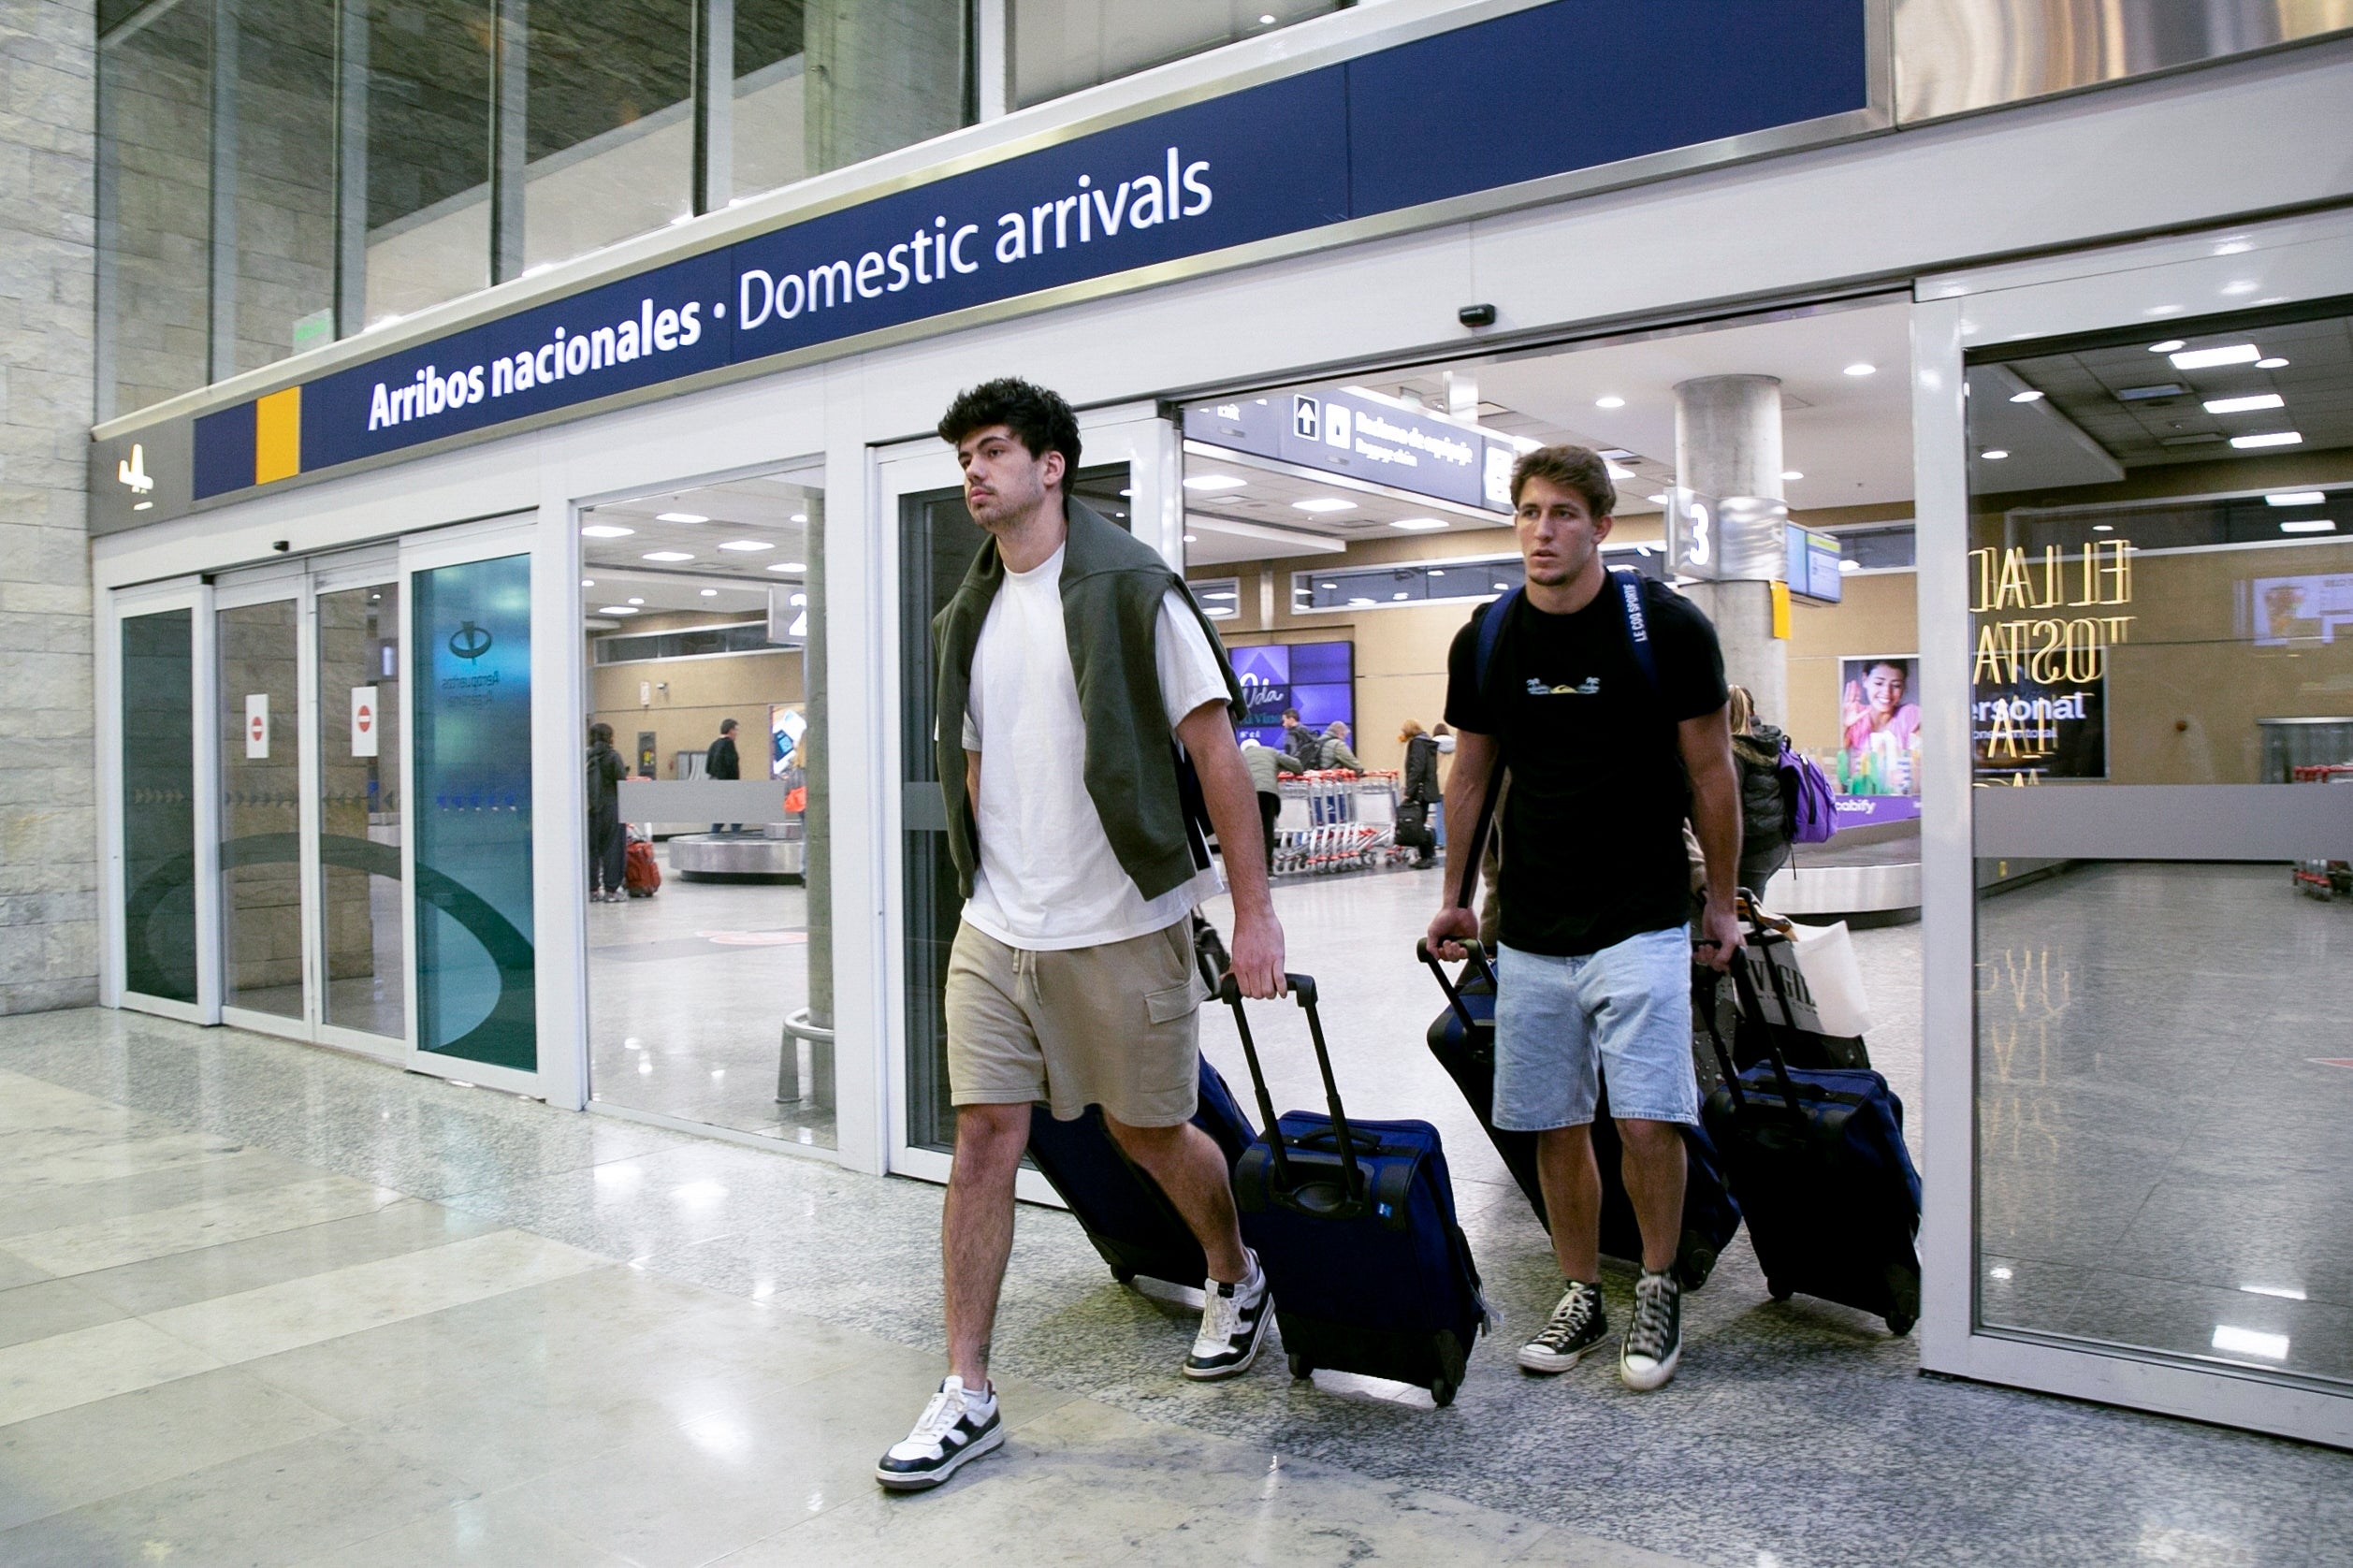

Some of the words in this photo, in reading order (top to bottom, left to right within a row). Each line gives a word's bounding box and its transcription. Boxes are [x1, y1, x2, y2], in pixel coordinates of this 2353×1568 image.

[368, 363, 486, 432] Arribos
[491, 298, 702, 398] nacionales
[739, 214, 980, 331] Domestic
[995, 147, 1213, 263] arrivals
[1689, 502, 1710, 566] 3
[789, 592, 807, 637] 2
[1971, 691, 2086, 721] rsonal
